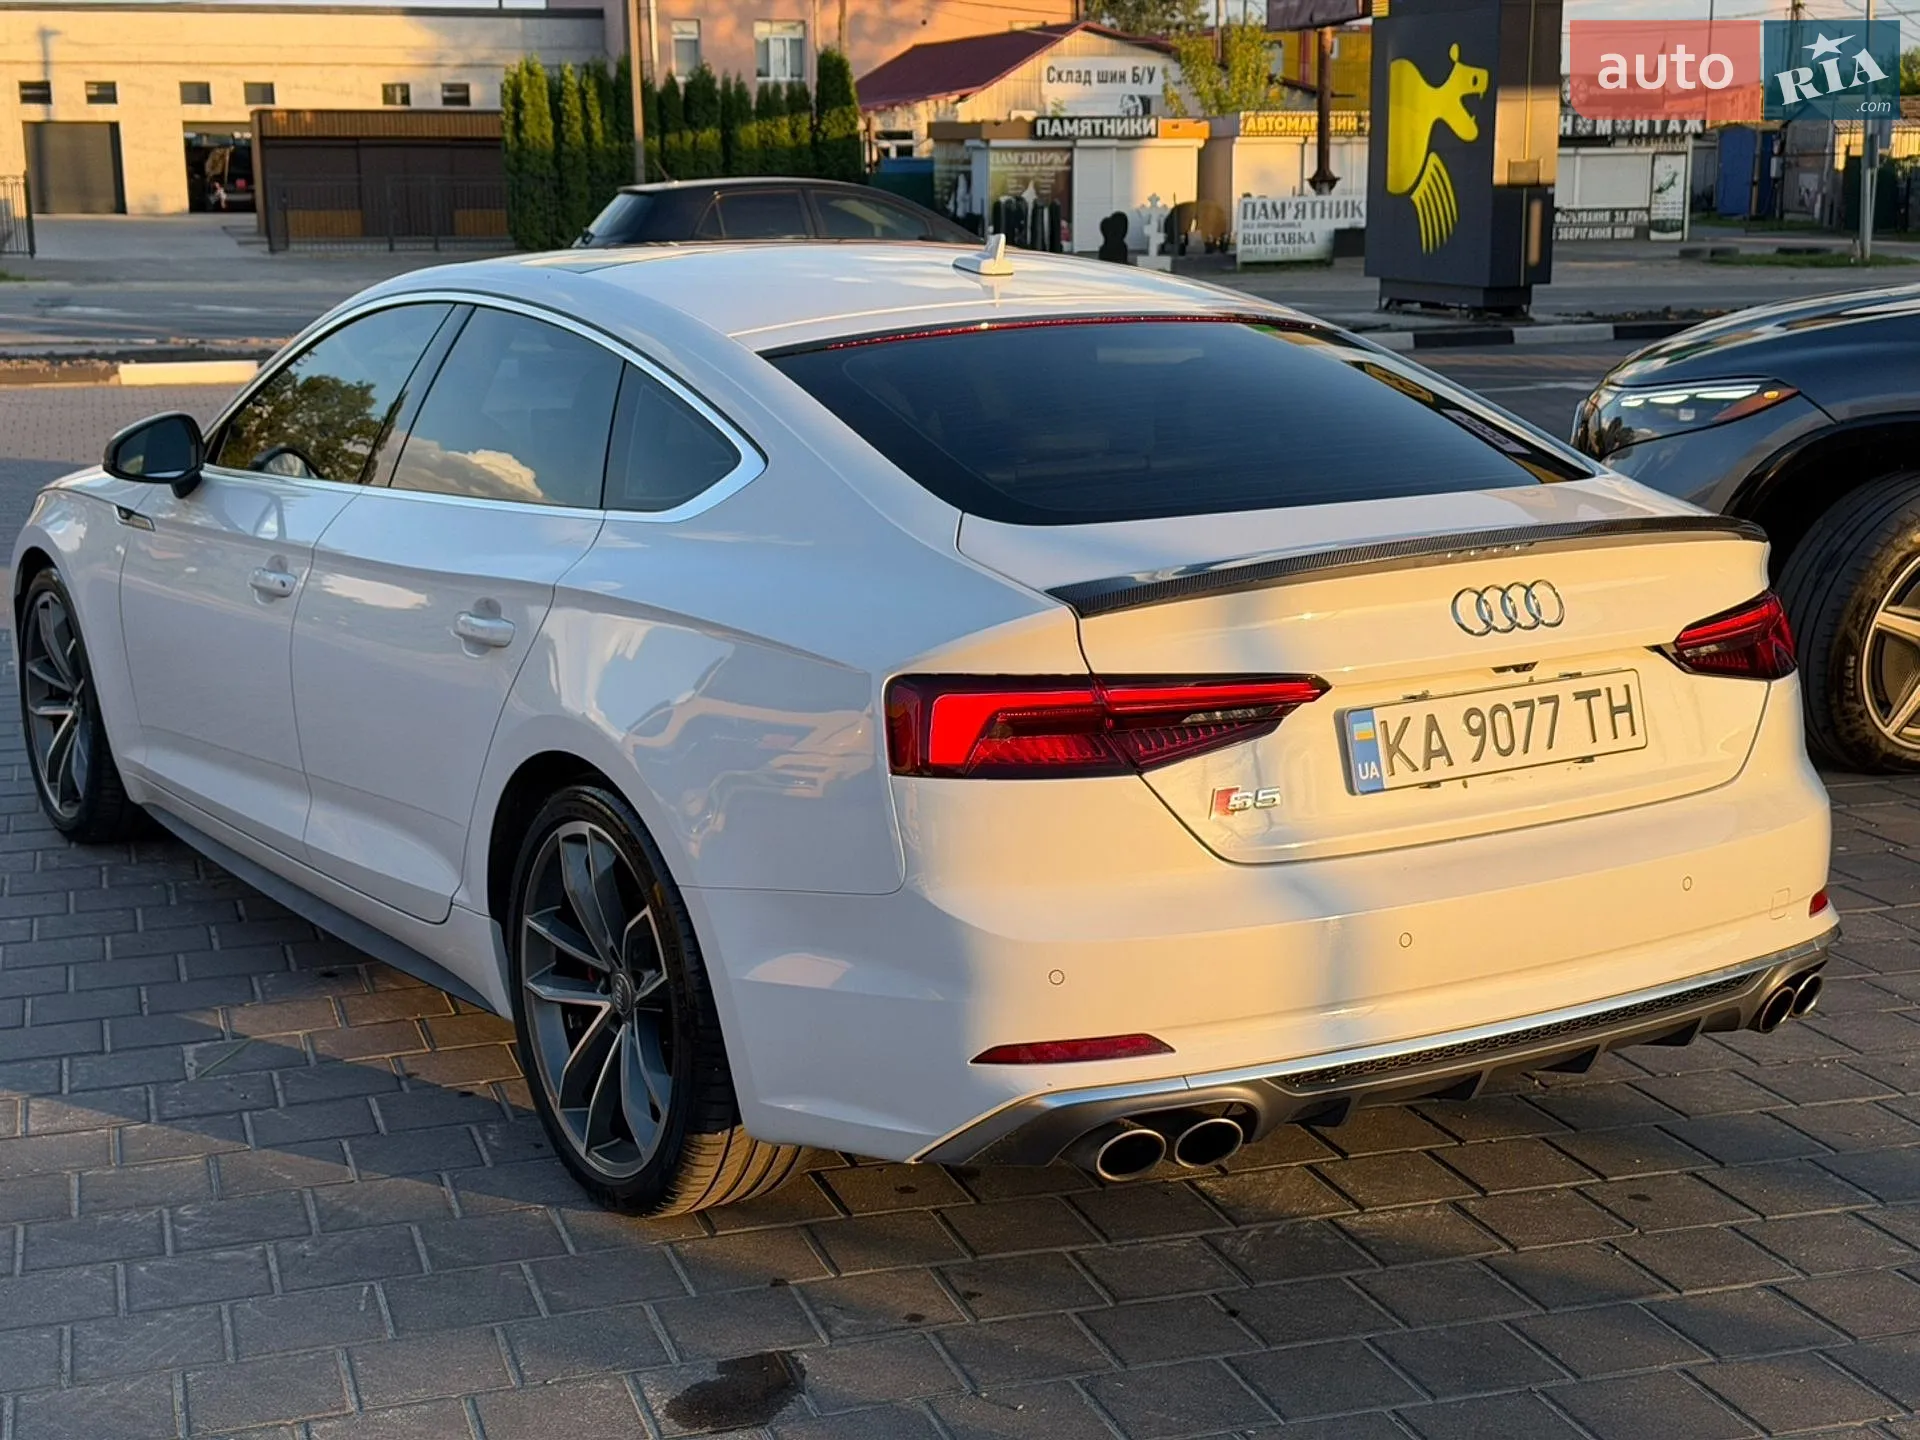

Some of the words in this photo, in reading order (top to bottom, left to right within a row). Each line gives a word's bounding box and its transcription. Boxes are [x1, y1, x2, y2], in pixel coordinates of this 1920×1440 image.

[1046, 66, 1092, 86] Склад
[1097, 70, 1127, 84] шин
[1131, 66, 1156, 85] Б/У
[1036, 117, 1157, 137] ПАМЯТНИКИ
[1242, 231, 1317, 246] ВИСТАВКА
[1380, 713, 1454, 777] KA
[1462, 694, 1561, 763] 9077
[1573, 684, 1638, 744] TH
[1358, 763, 1381, 781] UA
